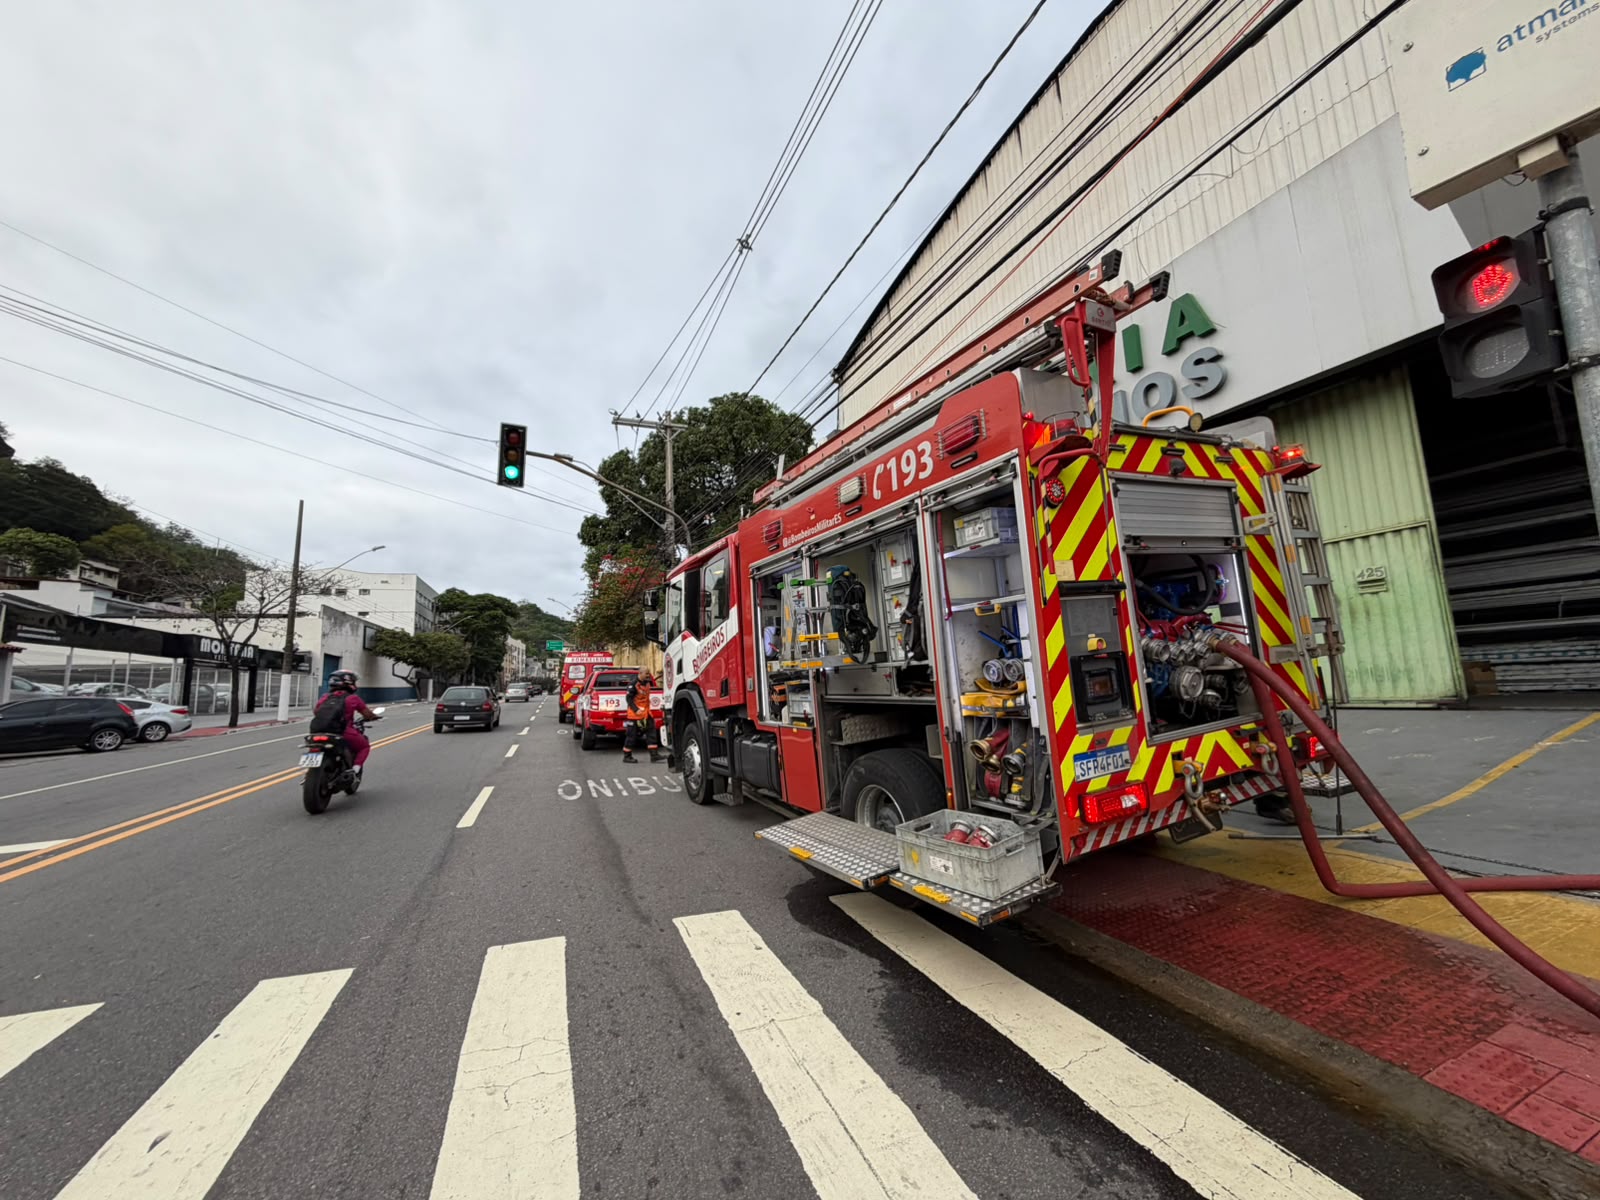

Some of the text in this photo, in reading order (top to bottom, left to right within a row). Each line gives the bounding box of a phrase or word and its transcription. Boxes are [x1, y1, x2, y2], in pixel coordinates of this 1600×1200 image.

[886, 440, 934, 492] 193
[1356, 566, 1385, 580] 425
[692, 626, 725, 675] BOMBEIROS
[605, 698, 620, 708] 193
[1080, 753, 1125, 777] SFR4F01
[557, 775, 684, 800] ONIBU
